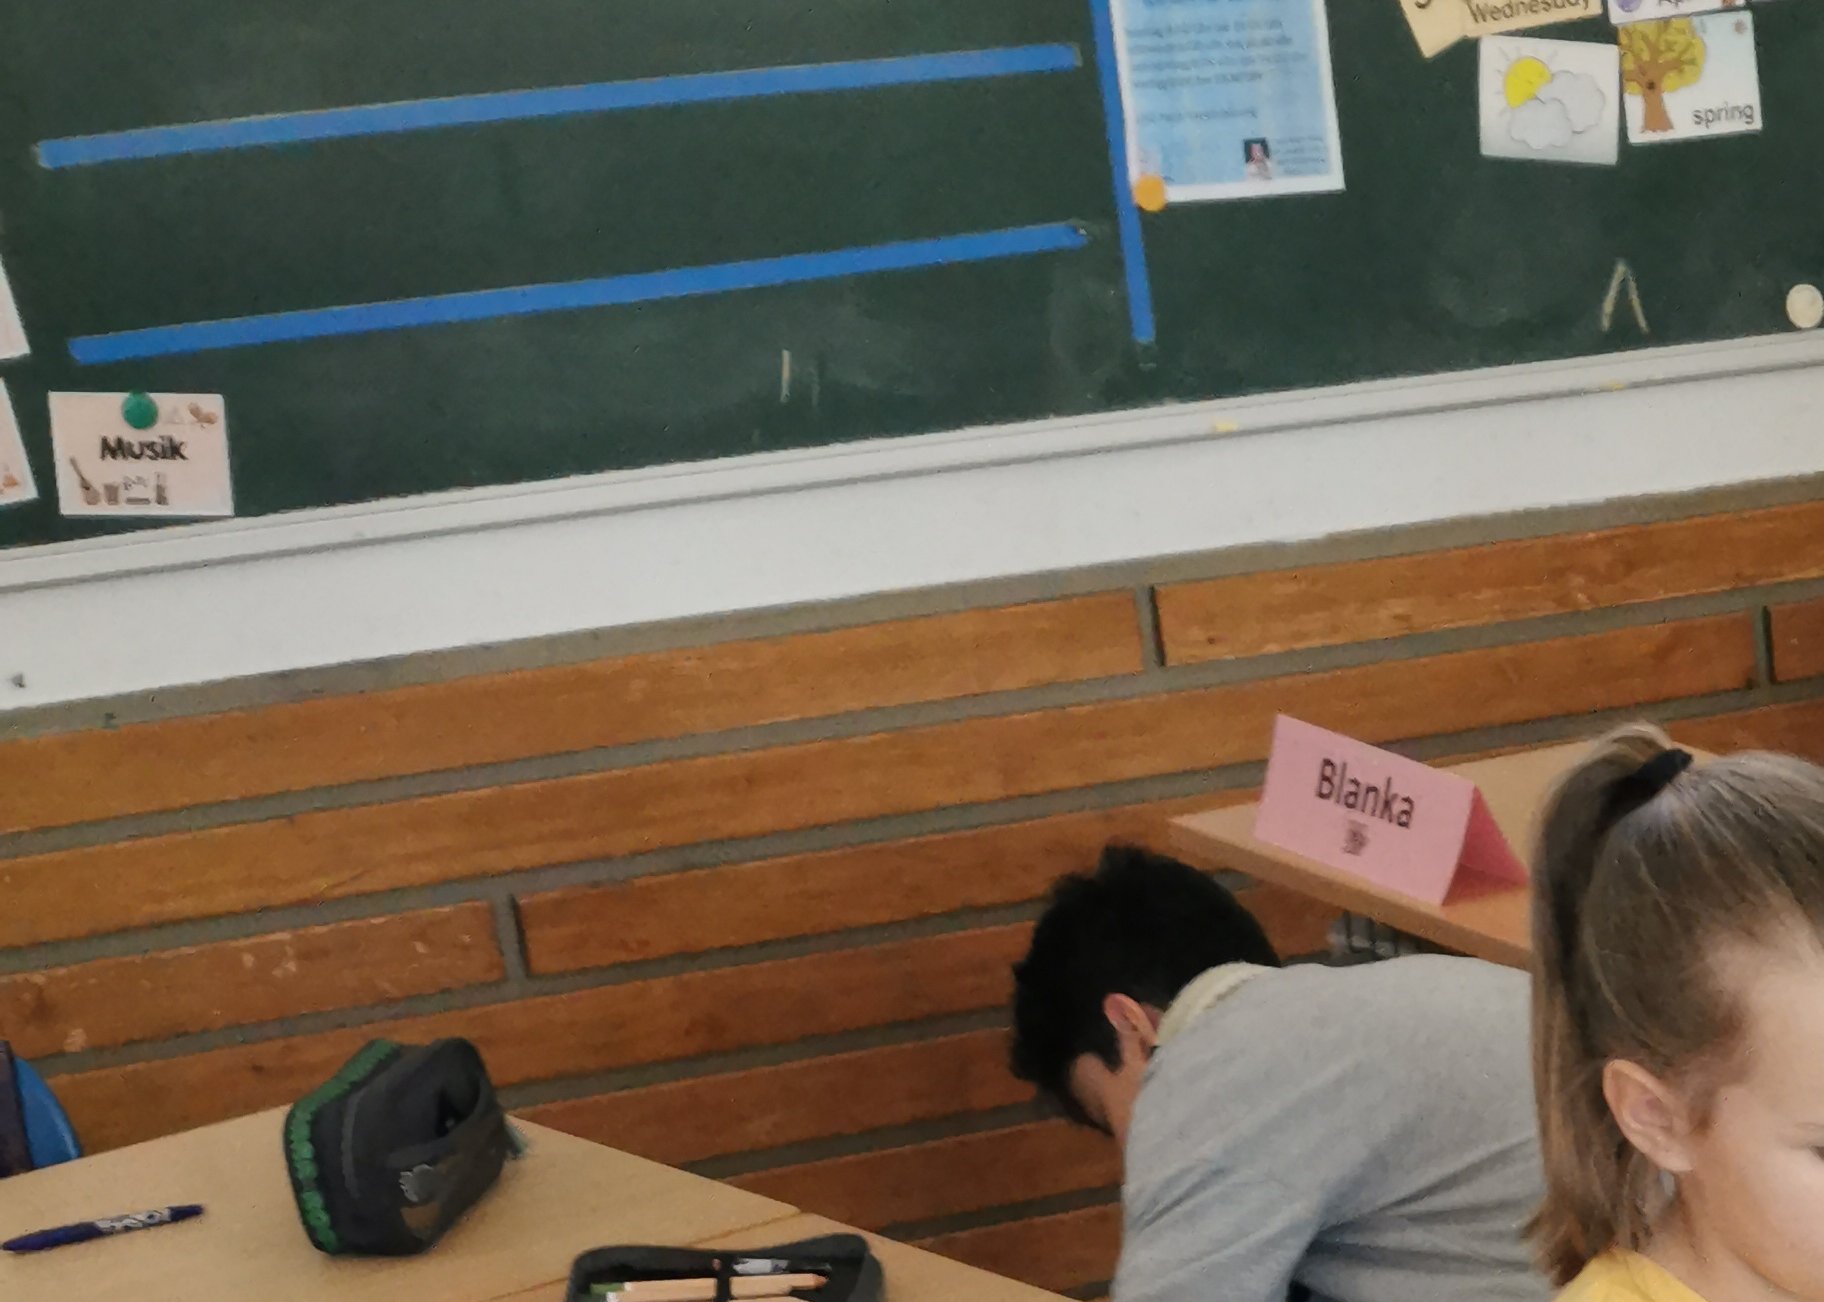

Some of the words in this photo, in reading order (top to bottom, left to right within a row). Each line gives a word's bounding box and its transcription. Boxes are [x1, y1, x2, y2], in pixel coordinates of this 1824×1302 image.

[1692, 103, 1755, 129] spring
[100, 434, 189, 461] Musik
[1314, 757, 1416, 830] Blanka
